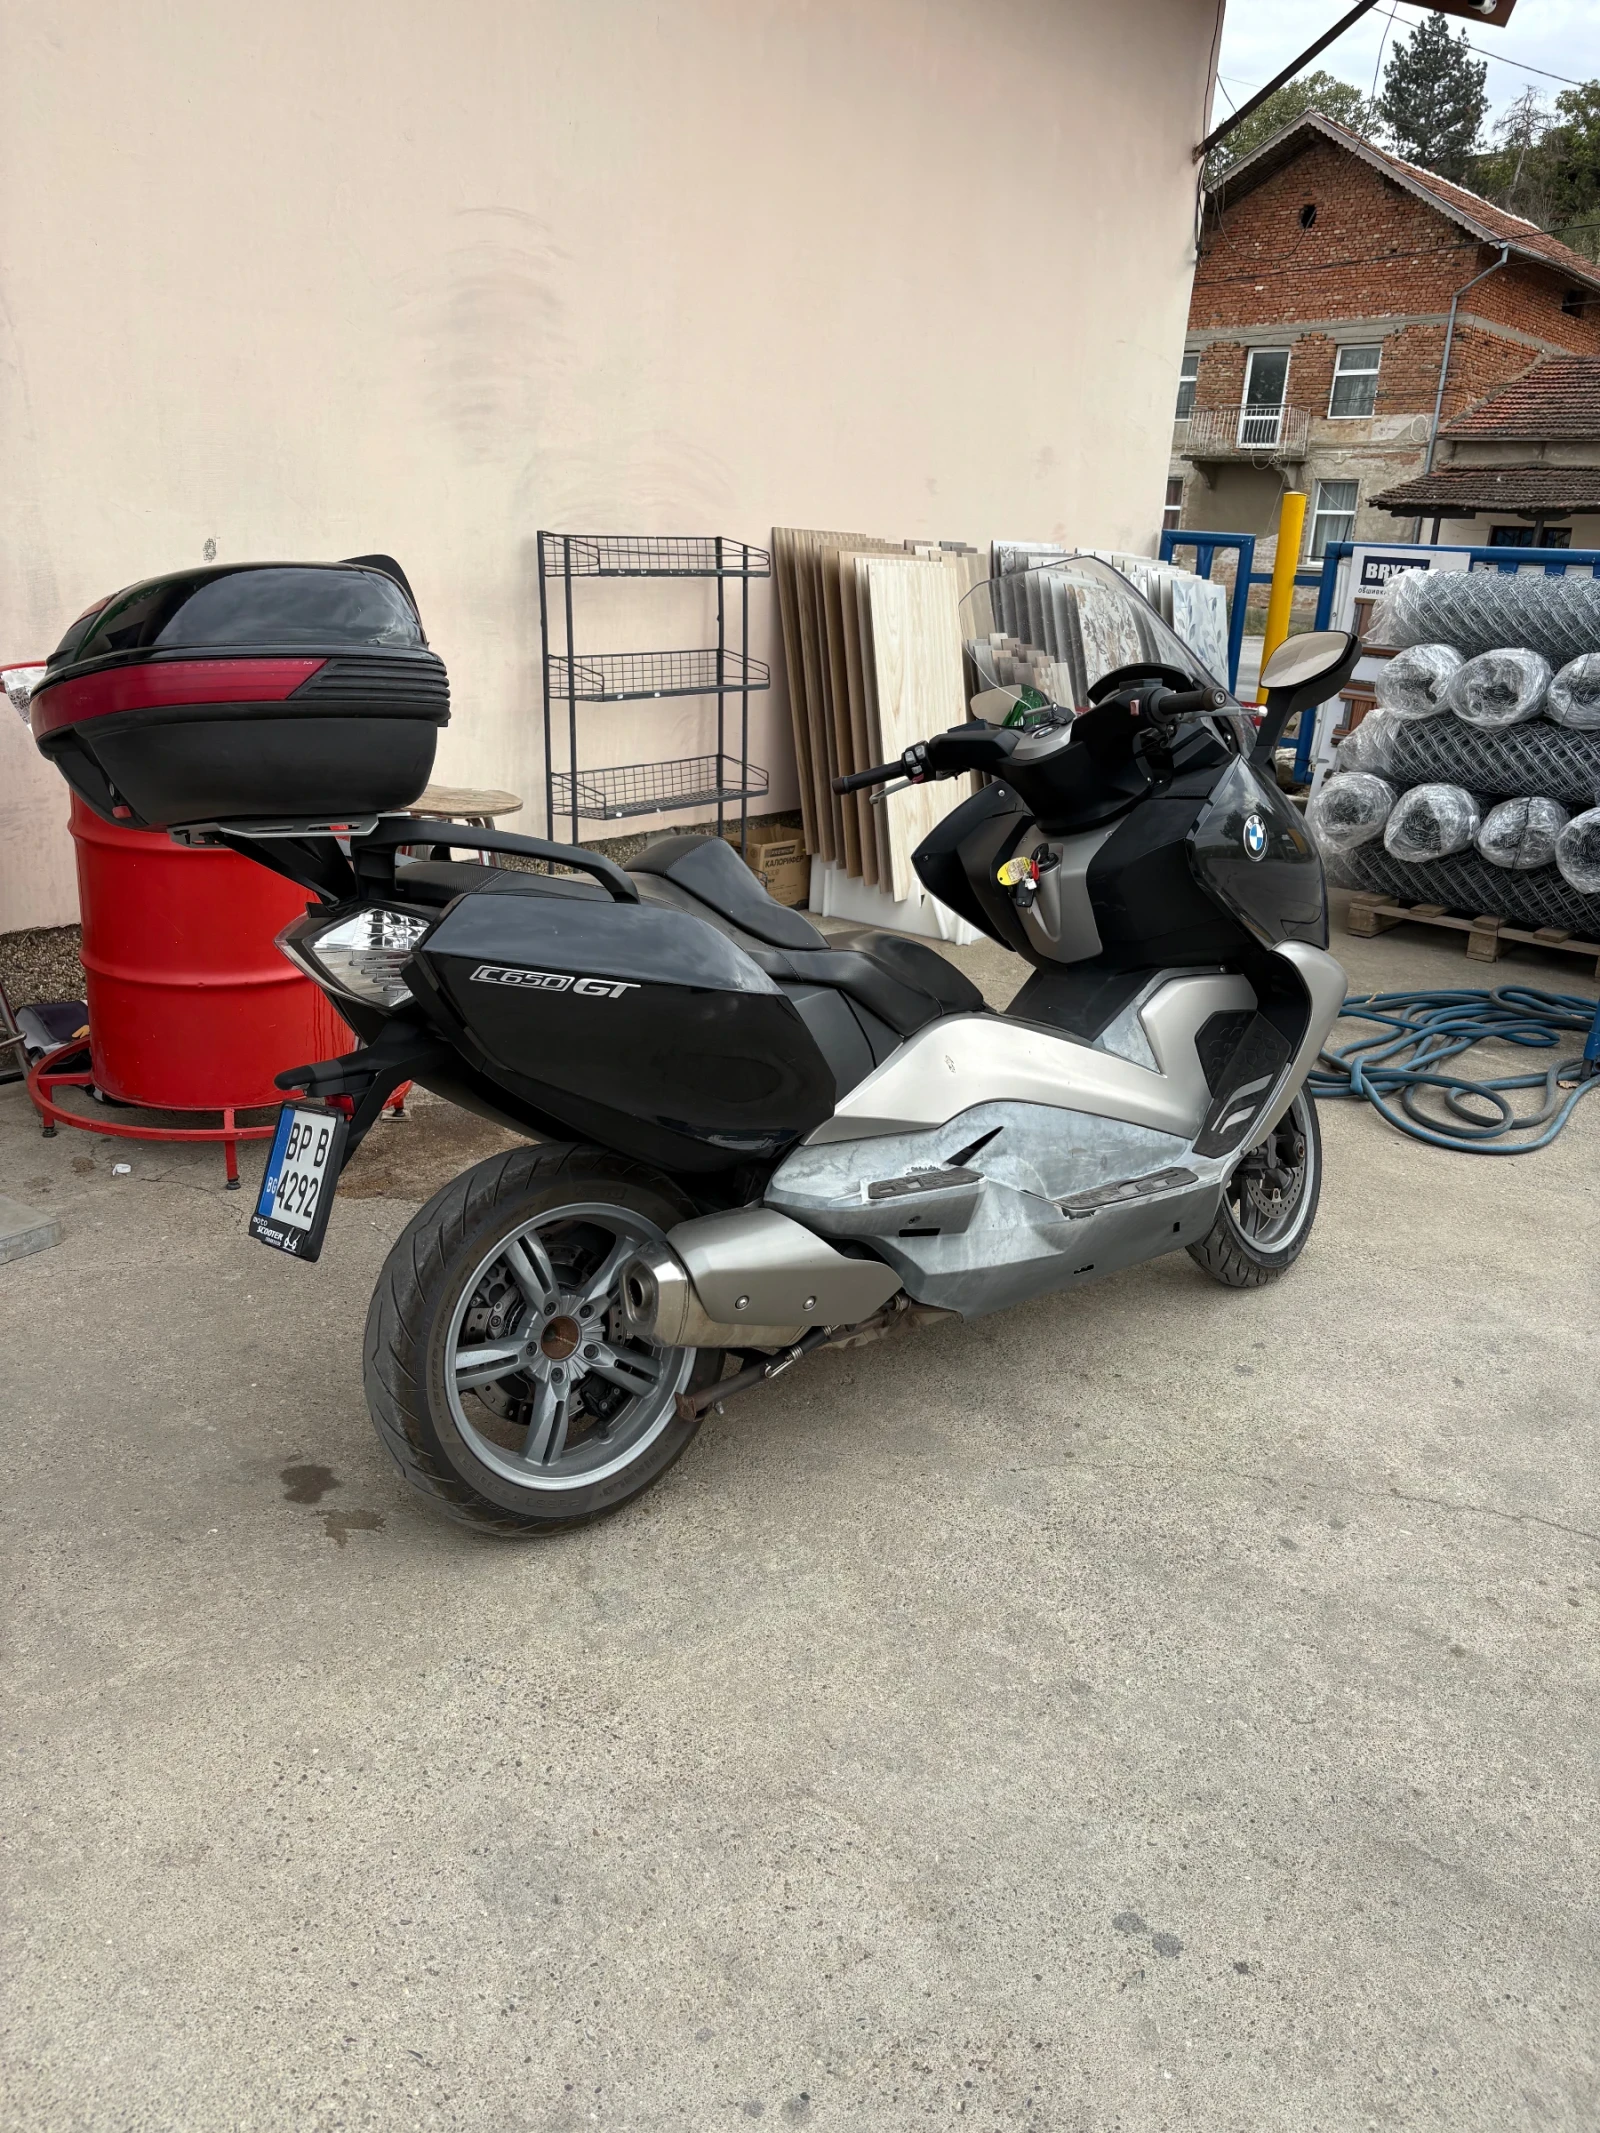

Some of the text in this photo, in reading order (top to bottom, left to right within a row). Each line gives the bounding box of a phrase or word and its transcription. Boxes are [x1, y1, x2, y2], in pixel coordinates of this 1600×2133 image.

[1365, 562, 1422, 580] BRY
[766, 855, 803, 867] КАЛОРИФЕР
[572, 977, 642, 999] GT
[313, 1128, 330, 1168] B
[266, 1175, 278, 1194] BG
[276, 1169, 319, 1219] 4292
[256, 1224, 284, 1242] SCOOTER
